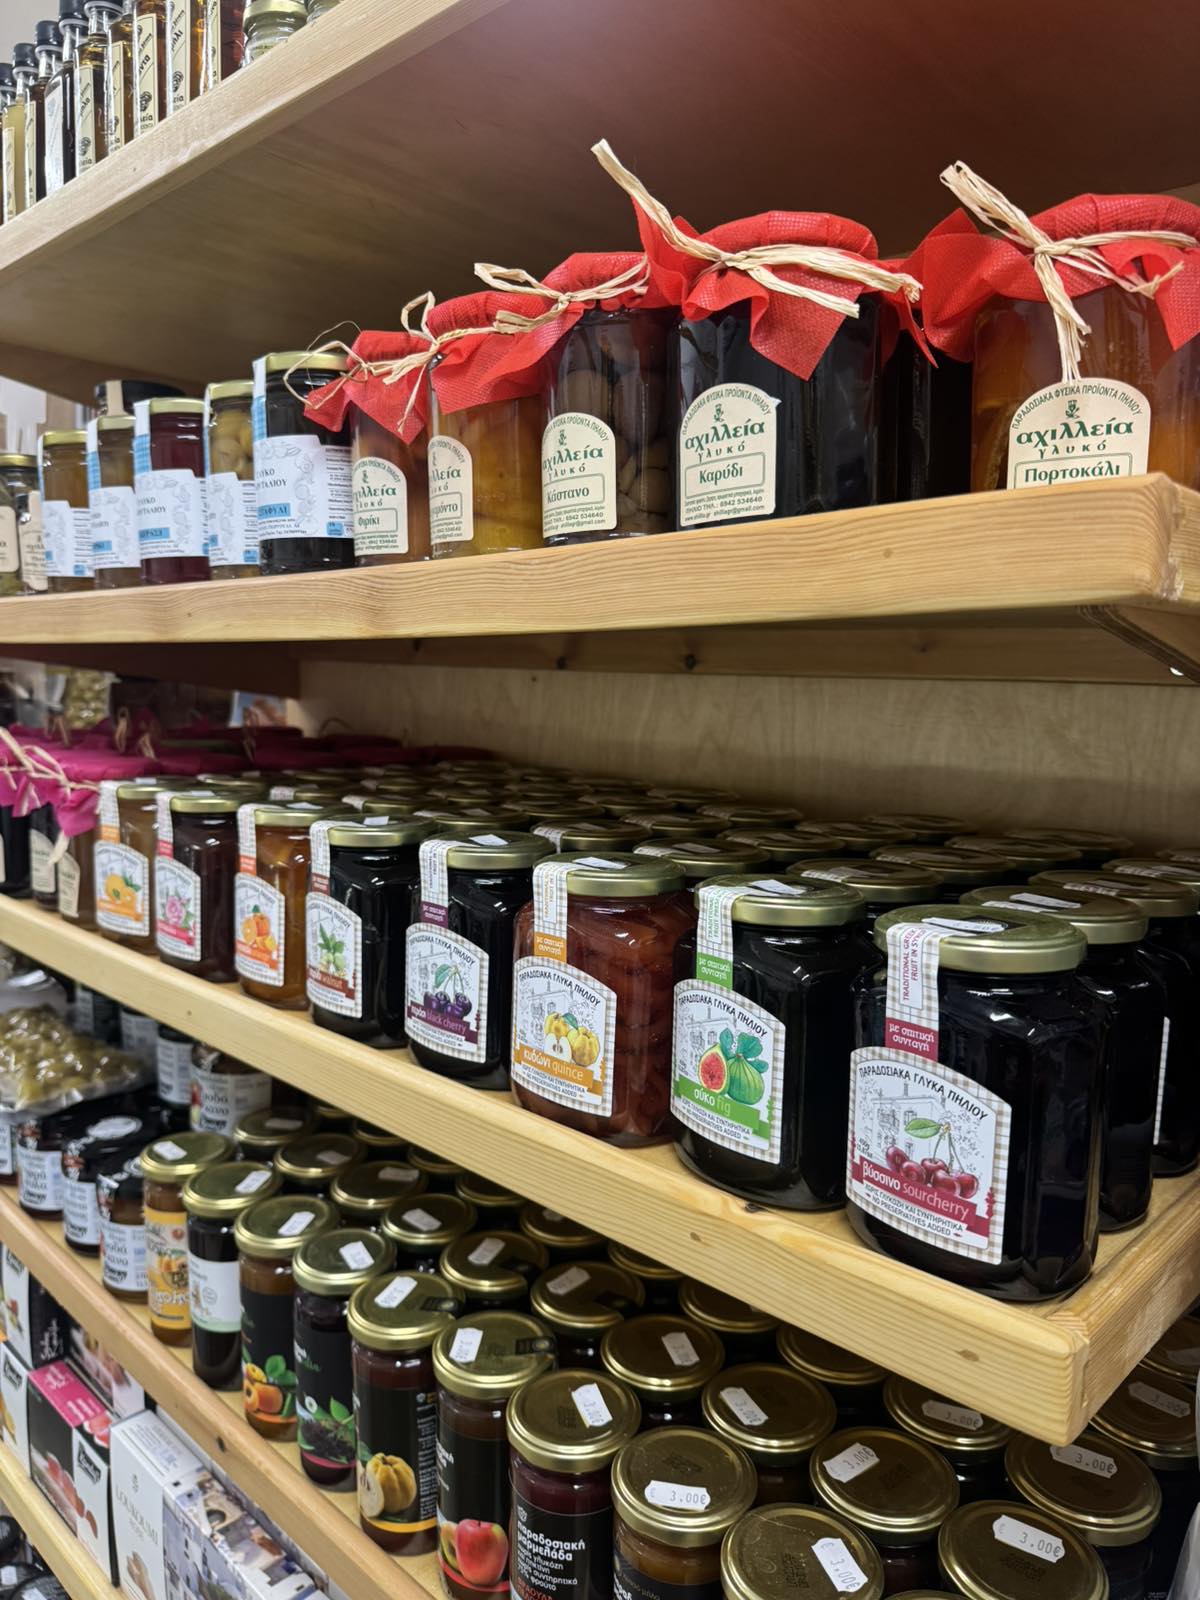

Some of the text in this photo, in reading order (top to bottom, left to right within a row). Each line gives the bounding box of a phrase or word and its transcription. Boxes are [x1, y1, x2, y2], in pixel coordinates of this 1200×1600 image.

[1012, 383, 1143, 429] ΠΑΡΑΔΟΣΙΑΚΑ ΦΥΣΙΚΑ ΠΡΟΪΟΝΤΑ ΠΗΛΙΟΥ
[685, 418, 765, 452] αχιλλεία
[1016, 417, 1133, 448] αχιλλεία
[543, 444, 604, 472] αχιλλεία
[698, 440, 745, 462] γλυκό
[1038, 440, 1106, 459] γλυκό
[699, 462, 743, 486] Καρύδι
[1025, 461, 1120, 484] Πορτοκάλι
[547, 486, 590, 504] Κάστανο
[452, 946, 476, 966] ΠΗΛΙΟΥ
[911, 948, 918, 958] IN
[553, 972, 573, 991] ΓΛΥΚΑ
[574, 984, 601, 1008] ΠΗΛΙΟΥ
[443, 1017, 467, 1035] cherry
[713, 998, 736, 1018] ΓΛΥΚΑ
[737, 1011, 768, 1038] ΠΗΛΙΟΥ
[892, 1034, 930, 1052] συνταγή
[552, 1061, 584, 1081] quince
[694, 1087, 731, 1117] σύκο fig
[859, 1065, 989, 1121] ΠΑΡΑΔΟΣΙΑΚΑ ΓΛΥΚΑ ΠΗΛΙΟΥ
[862, 1160, 970, 1221] βύσσινο sourcherry
[879, 1200, 926, 1227] PRESERVATIVES
[927, 1222, 951, 1236] ADDED
[915, 1207, 964, 1231] ΣΥΝΤΗΡΗΤΙΚΑ
[843, 1447, 876, 1470] 3.00€
[1075, 1453, 1115, 1474] 3.00€
[669, 1490, 707, 1504] 3.00€
[517, 1520, 586, 1551] παραδοσιακή
[517, 1530, 573, 1561] μαρμελάδα
[1019, 1531, 1062, 1558] 3.00€
[830, 1556, 862, 1591] 3.00€
